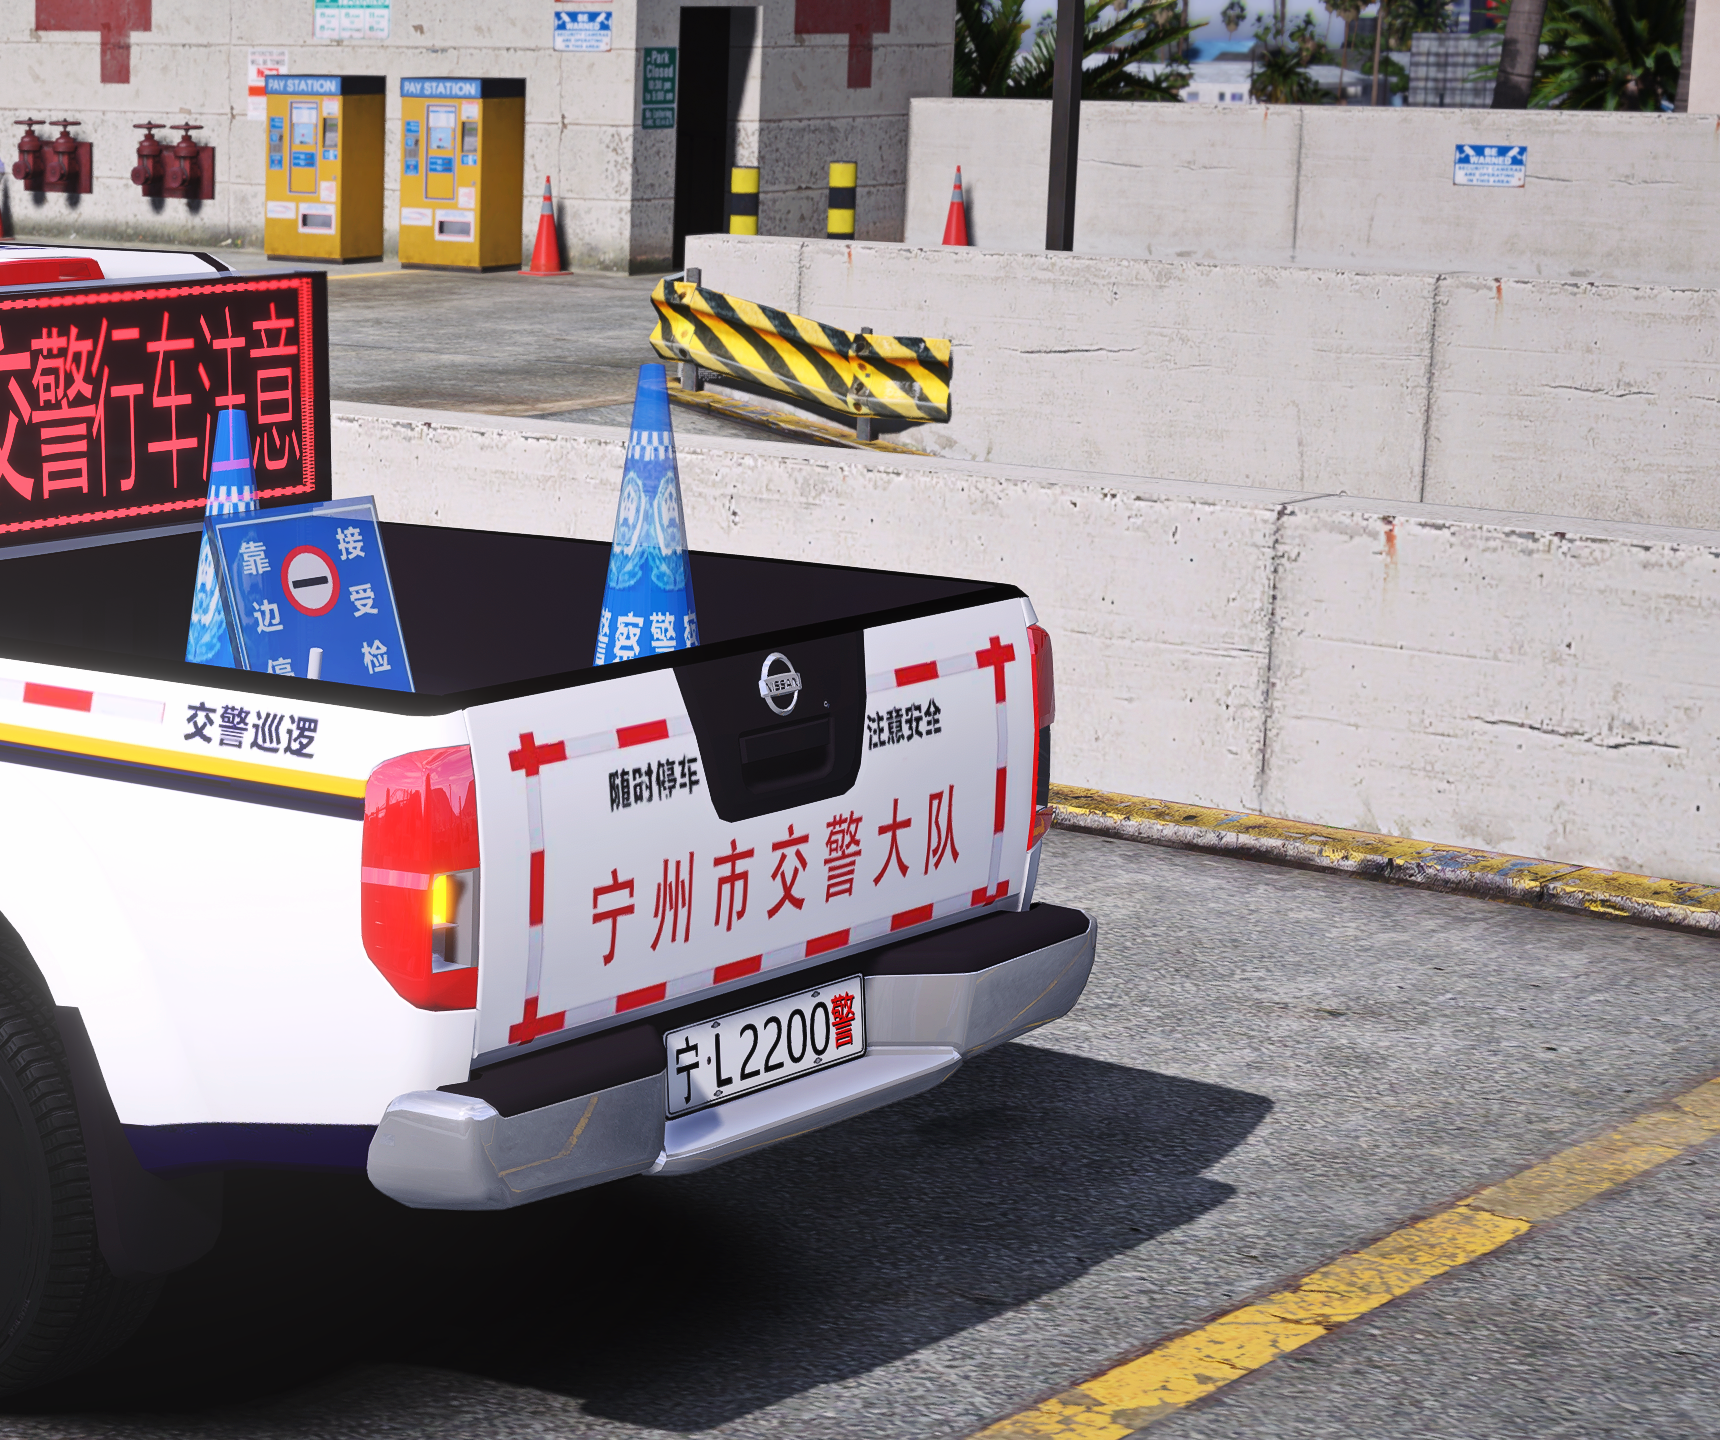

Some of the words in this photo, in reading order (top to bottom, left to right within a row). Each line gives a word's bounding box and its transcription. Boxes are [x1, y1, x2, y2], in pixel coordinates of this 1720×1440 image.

[577, 13, 589, 22] BE
[565, 22, 600, 30] WARNED
[651, 50, 669, 64] Park
[646, 65, 673, 78] Closed
[268, 78, 285, 91] PAY
[286, 79, 336, 93] STATION
[404, 82, 422, 94] PAY
[423, 82, 476, 95] STATION
[1484, 147, 1498, 156] BE
[1469, 156, 1512, 165] WARNED
[183, 701, 319, 759] 交警巡逻
[867, 697, 942, 751] 注意安全
[608, 753, 700, 813] 随时停车
[592, 784, 960, 967] 宁州市交警大队
